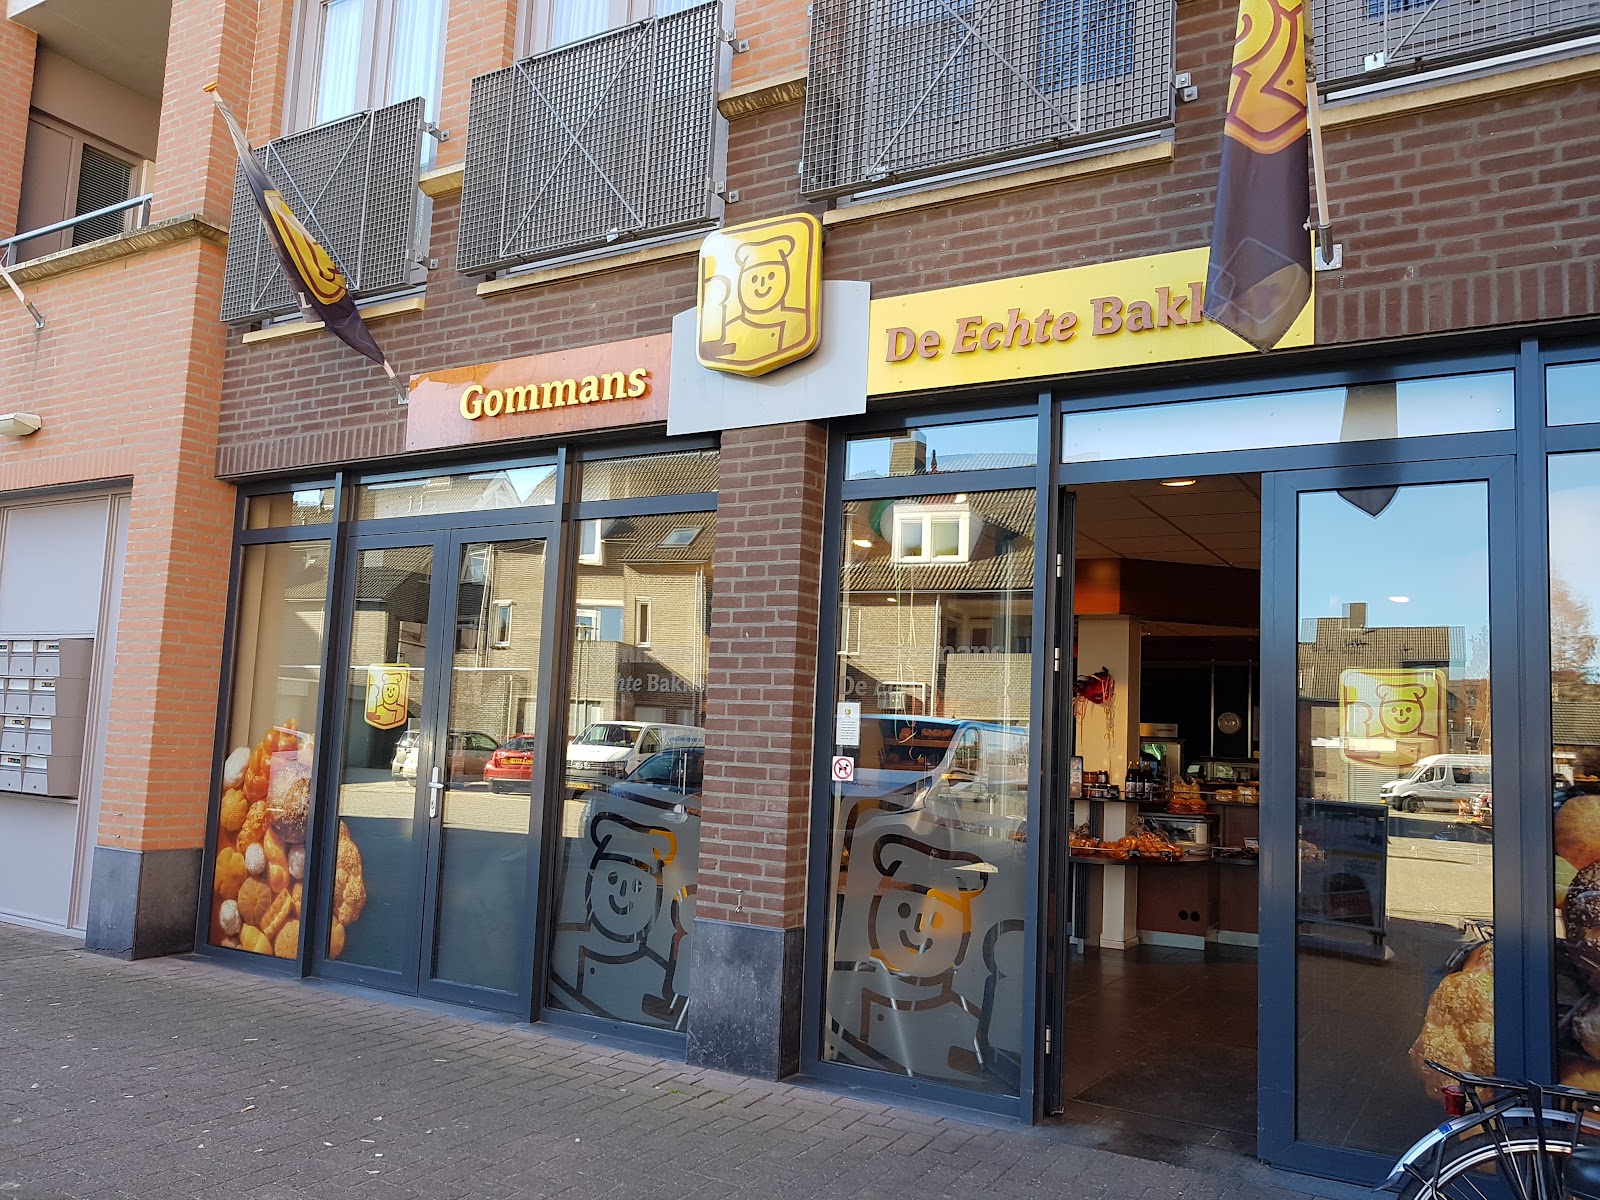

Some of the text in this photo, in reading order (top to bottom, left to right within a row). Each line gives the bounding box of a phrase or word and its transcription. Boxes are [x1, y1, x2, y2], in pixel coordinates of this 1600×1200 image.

[886, 281, 1205, 363] De Echte Bakk
[459, 368, 648, 420] Gommans
